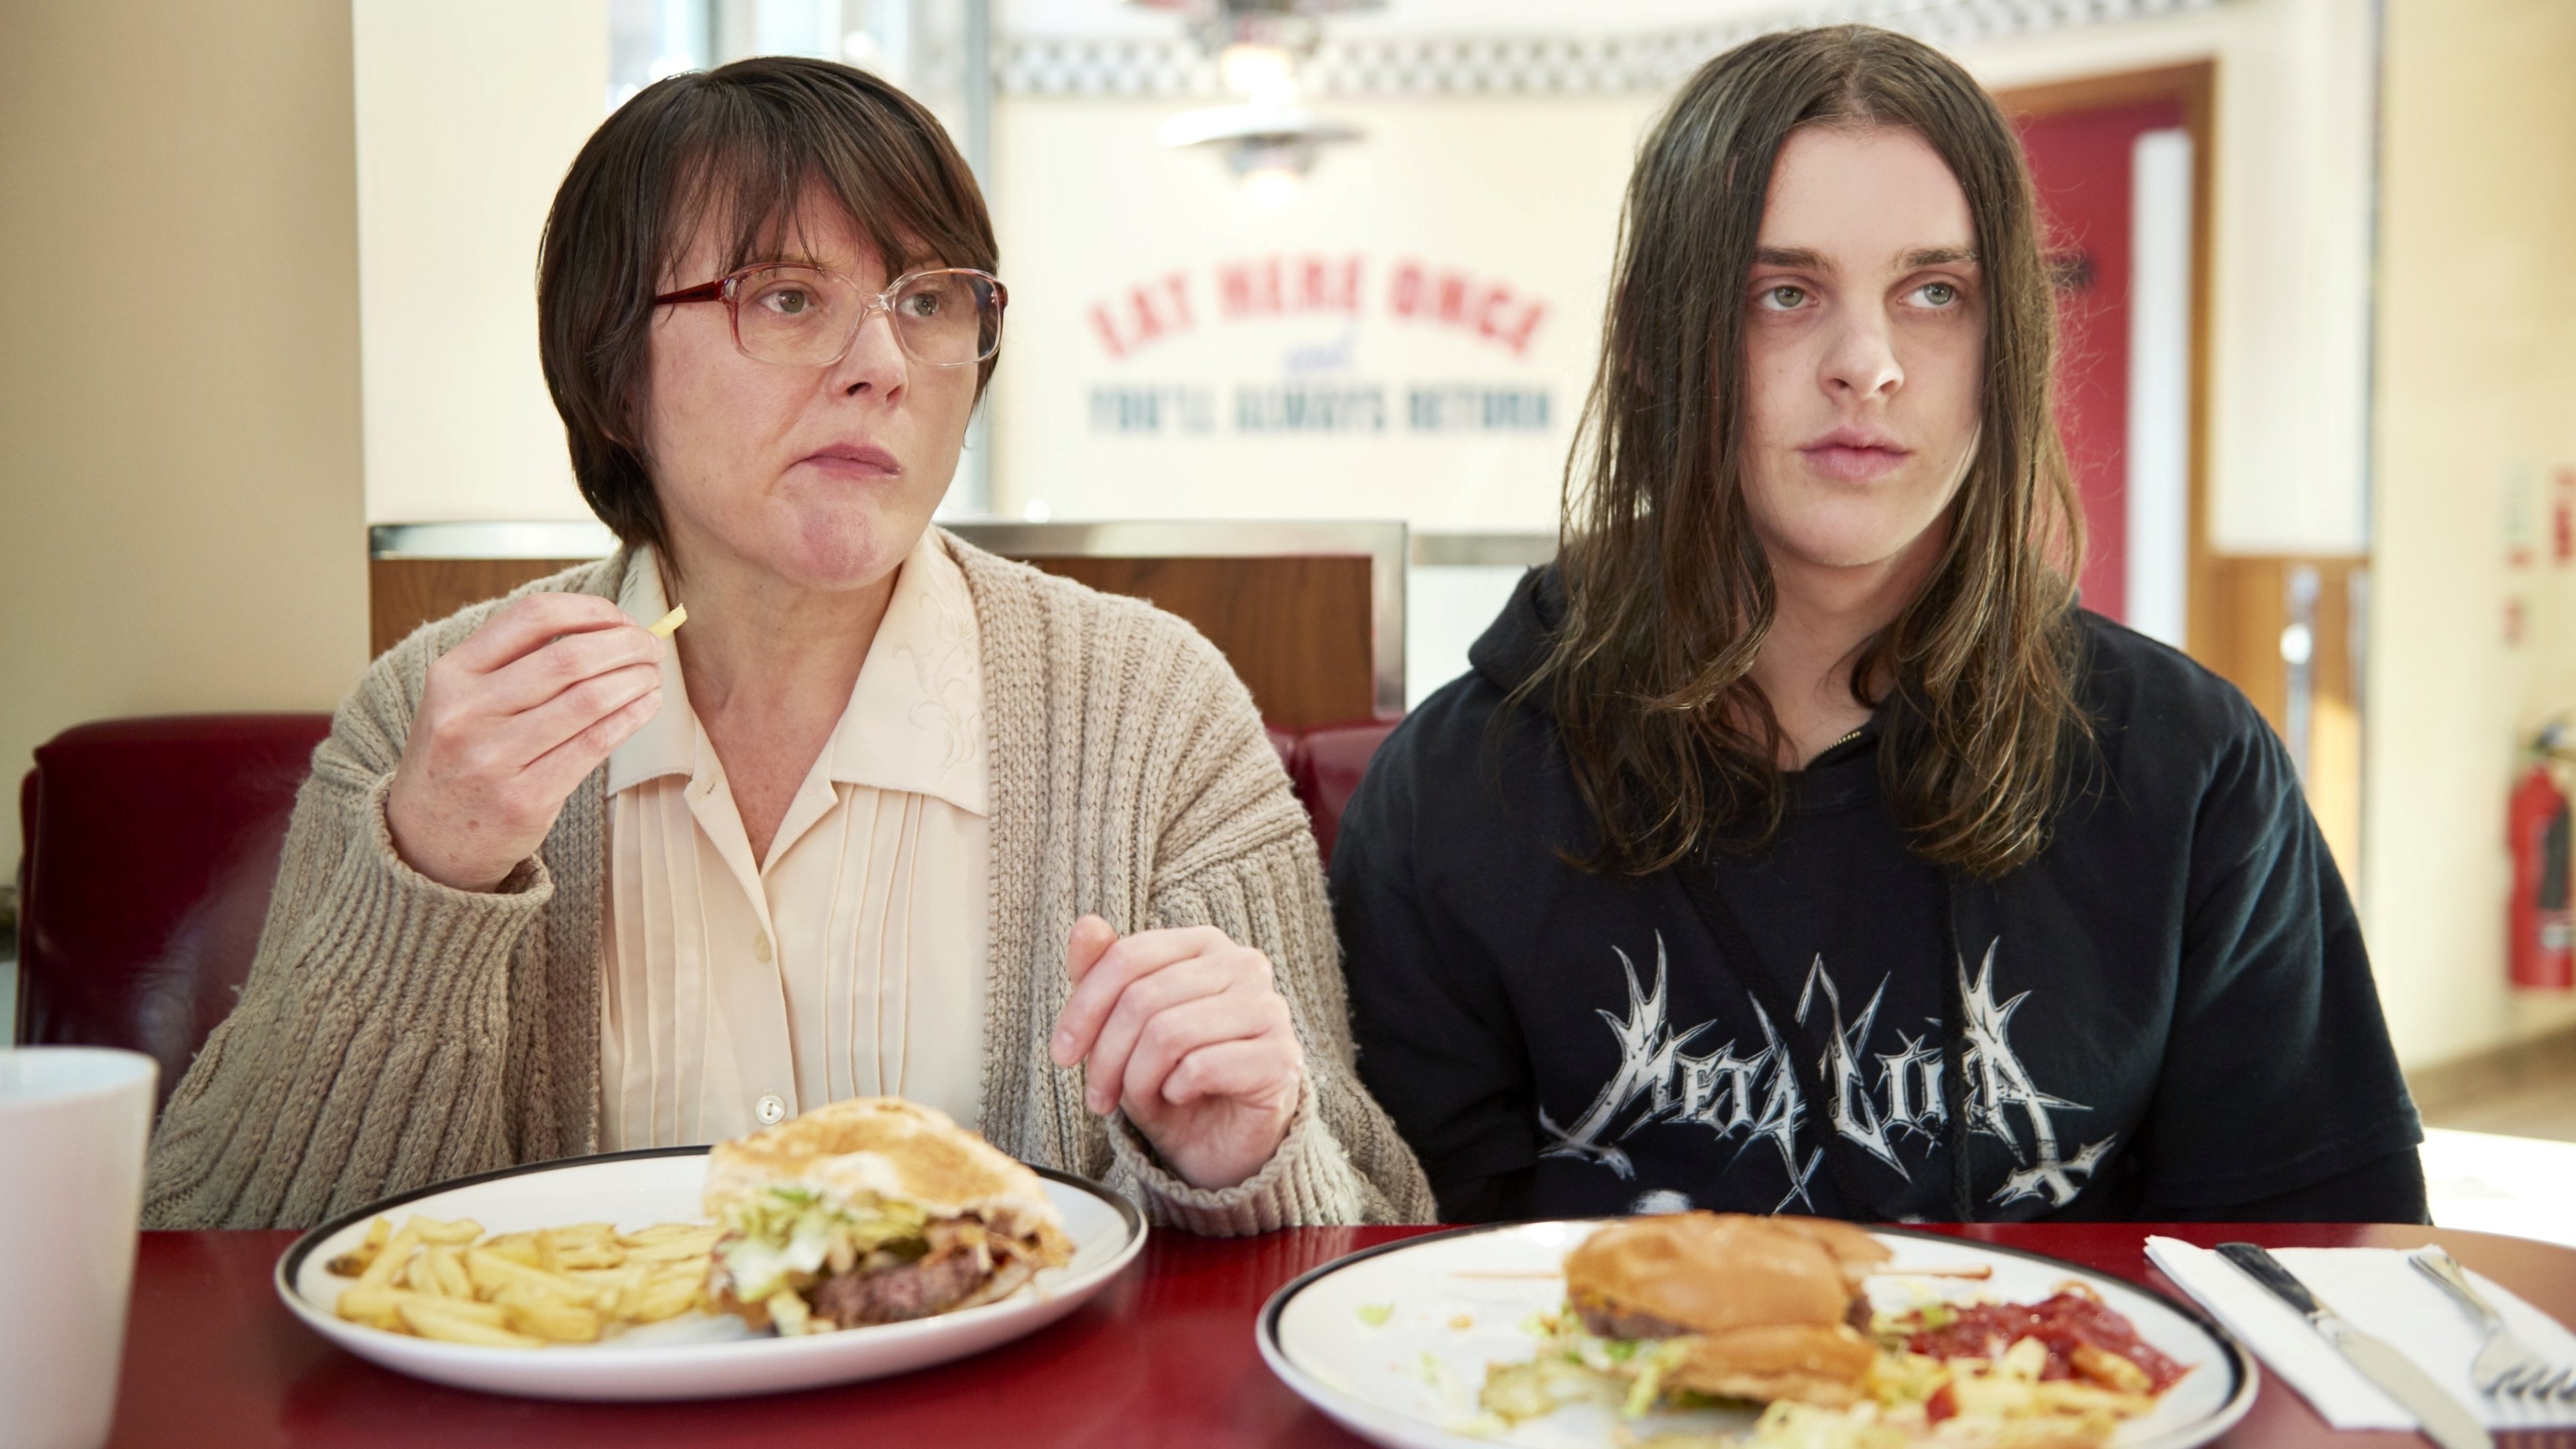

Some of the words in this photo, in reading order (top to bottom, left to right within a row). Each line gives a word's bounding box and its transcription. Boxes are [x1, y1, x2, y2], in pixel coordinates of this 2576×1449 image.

[1089, 268, 1197, 359] EAT
[1216, 254, 1360, 320] HERE
[1390, 256, 1551, 364] ONCE
[1232, 384, 1385, 433] ALWAYS
[1407, 384, 1552, 433] RETURN
[1538, 928, 2116, 1213] METALICA
